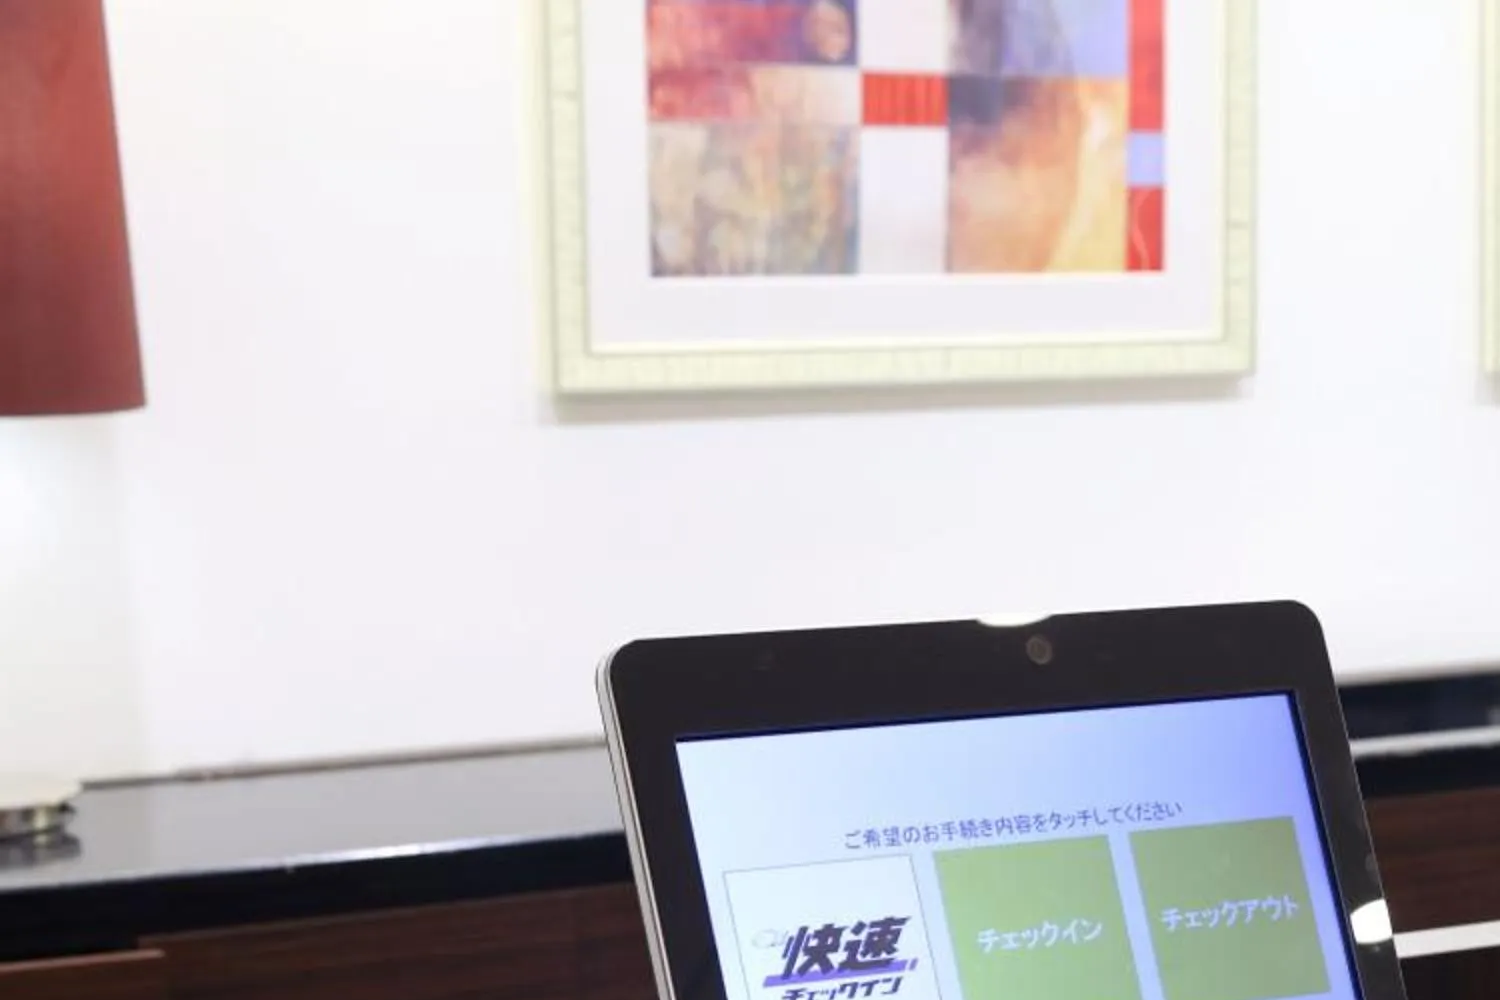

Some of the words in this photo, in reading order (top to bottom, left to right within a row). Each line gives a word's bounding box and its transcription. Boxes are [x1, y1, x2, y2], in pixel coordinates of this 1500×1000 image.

[845, 801, 1183, 850] ご希望のお手続き内容をタッチしてください
[1162, 895, 1299, 931] チェックアウト
[781, 916, 910, 980] 快速
[977, 919, 1102, 953] チェックイン
